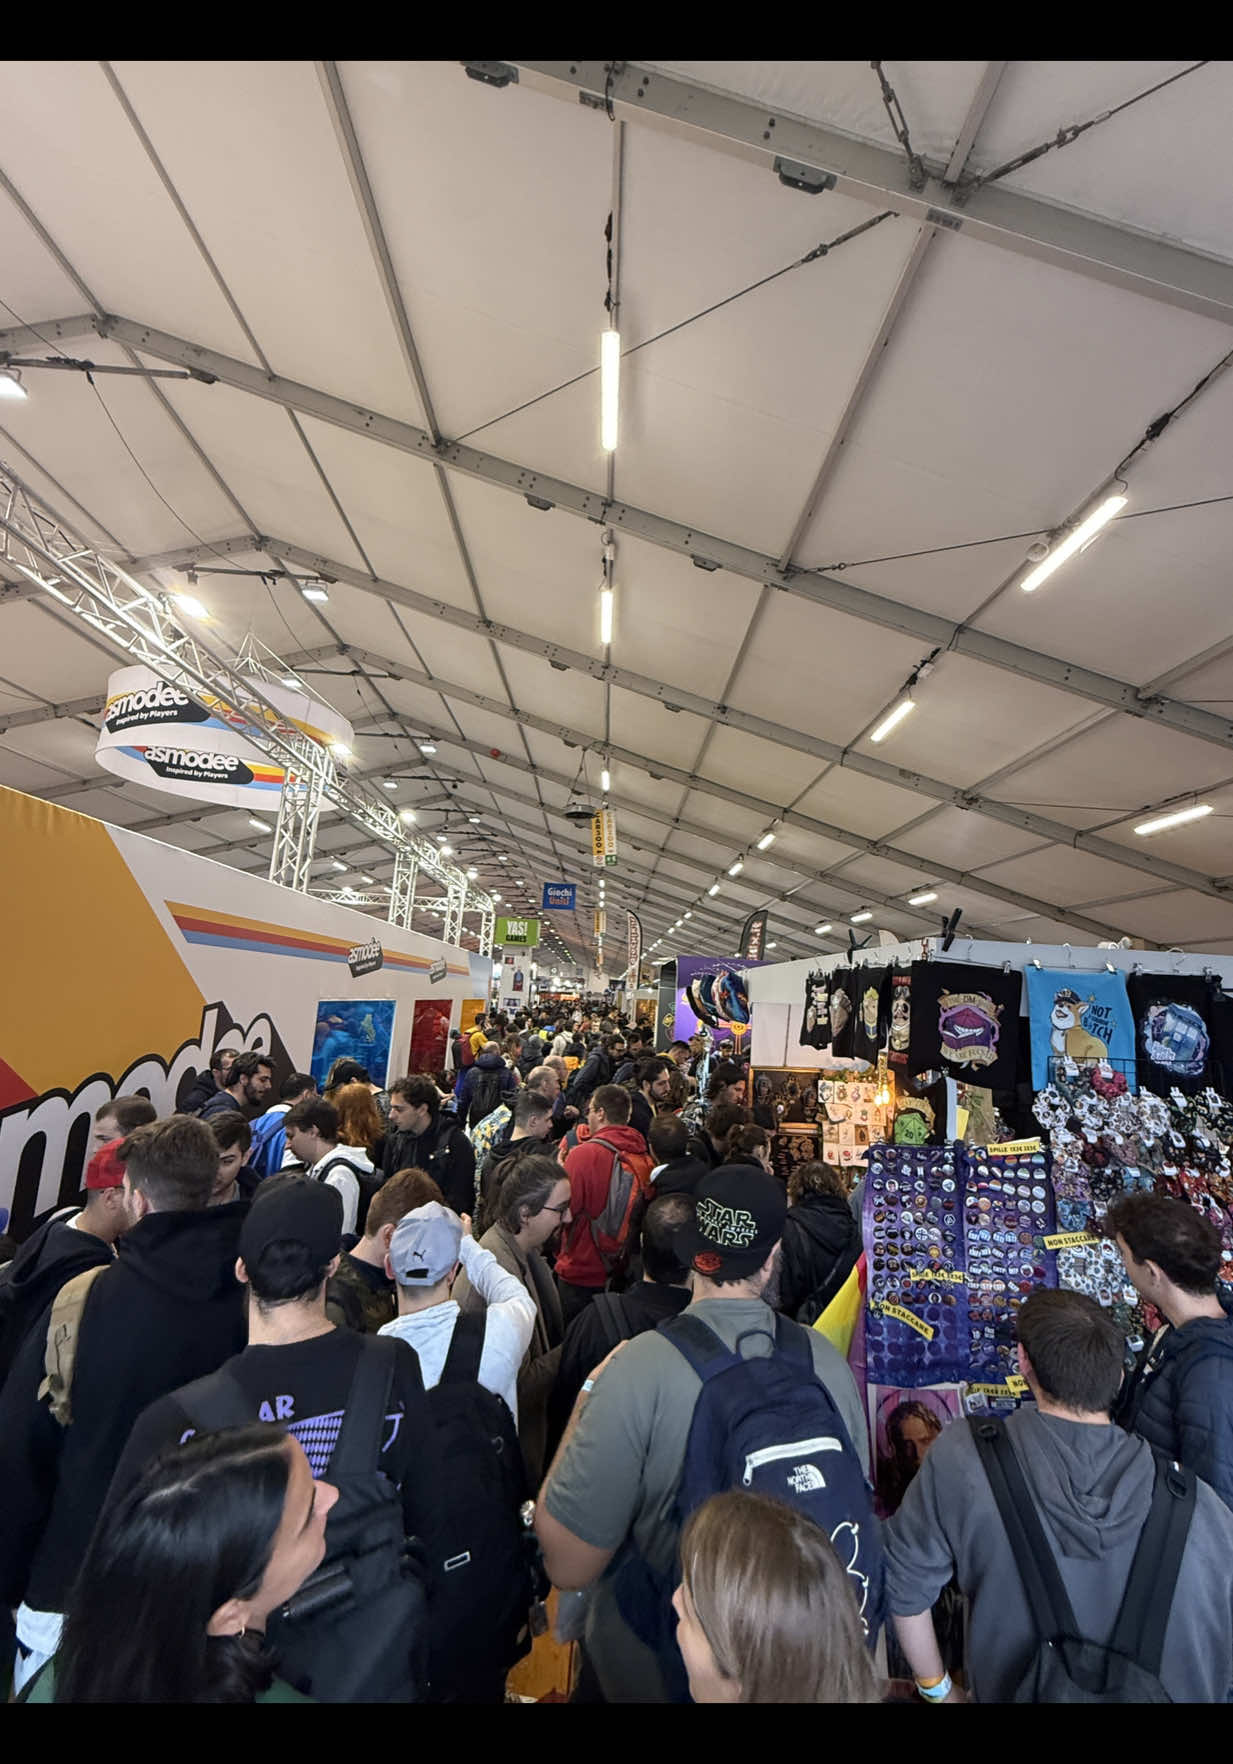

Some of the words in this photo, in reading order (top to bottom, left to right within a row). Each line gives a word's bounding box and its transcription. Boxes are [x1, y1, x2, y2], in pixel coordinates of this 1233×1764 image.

[116, 712, 139, 726] Inspired
[139, 711, 149, 720] by
[149, 708, 178, 718] Players
[144, 747, 239, 771] asmodee
[166, 766, 193, 776] Inspired
[194, 769, 203, 778] by
[202, 771, 229, 780] Players
[547, 887, 573, 897] Giochi
[506, 921, 529, 936] YAS!
[505, 935, 527, 943] GAMES
[1091, 1005, 1112, 1019] NOT
[696, 1197, 757, 1229] STAR
[1047, 1239, 1063, 1247] NON
[793, 1466, 810, 1476] THE
[787, 1473, 810, 1486] NORTH
[794, 1483, 813, 1494] FACE
